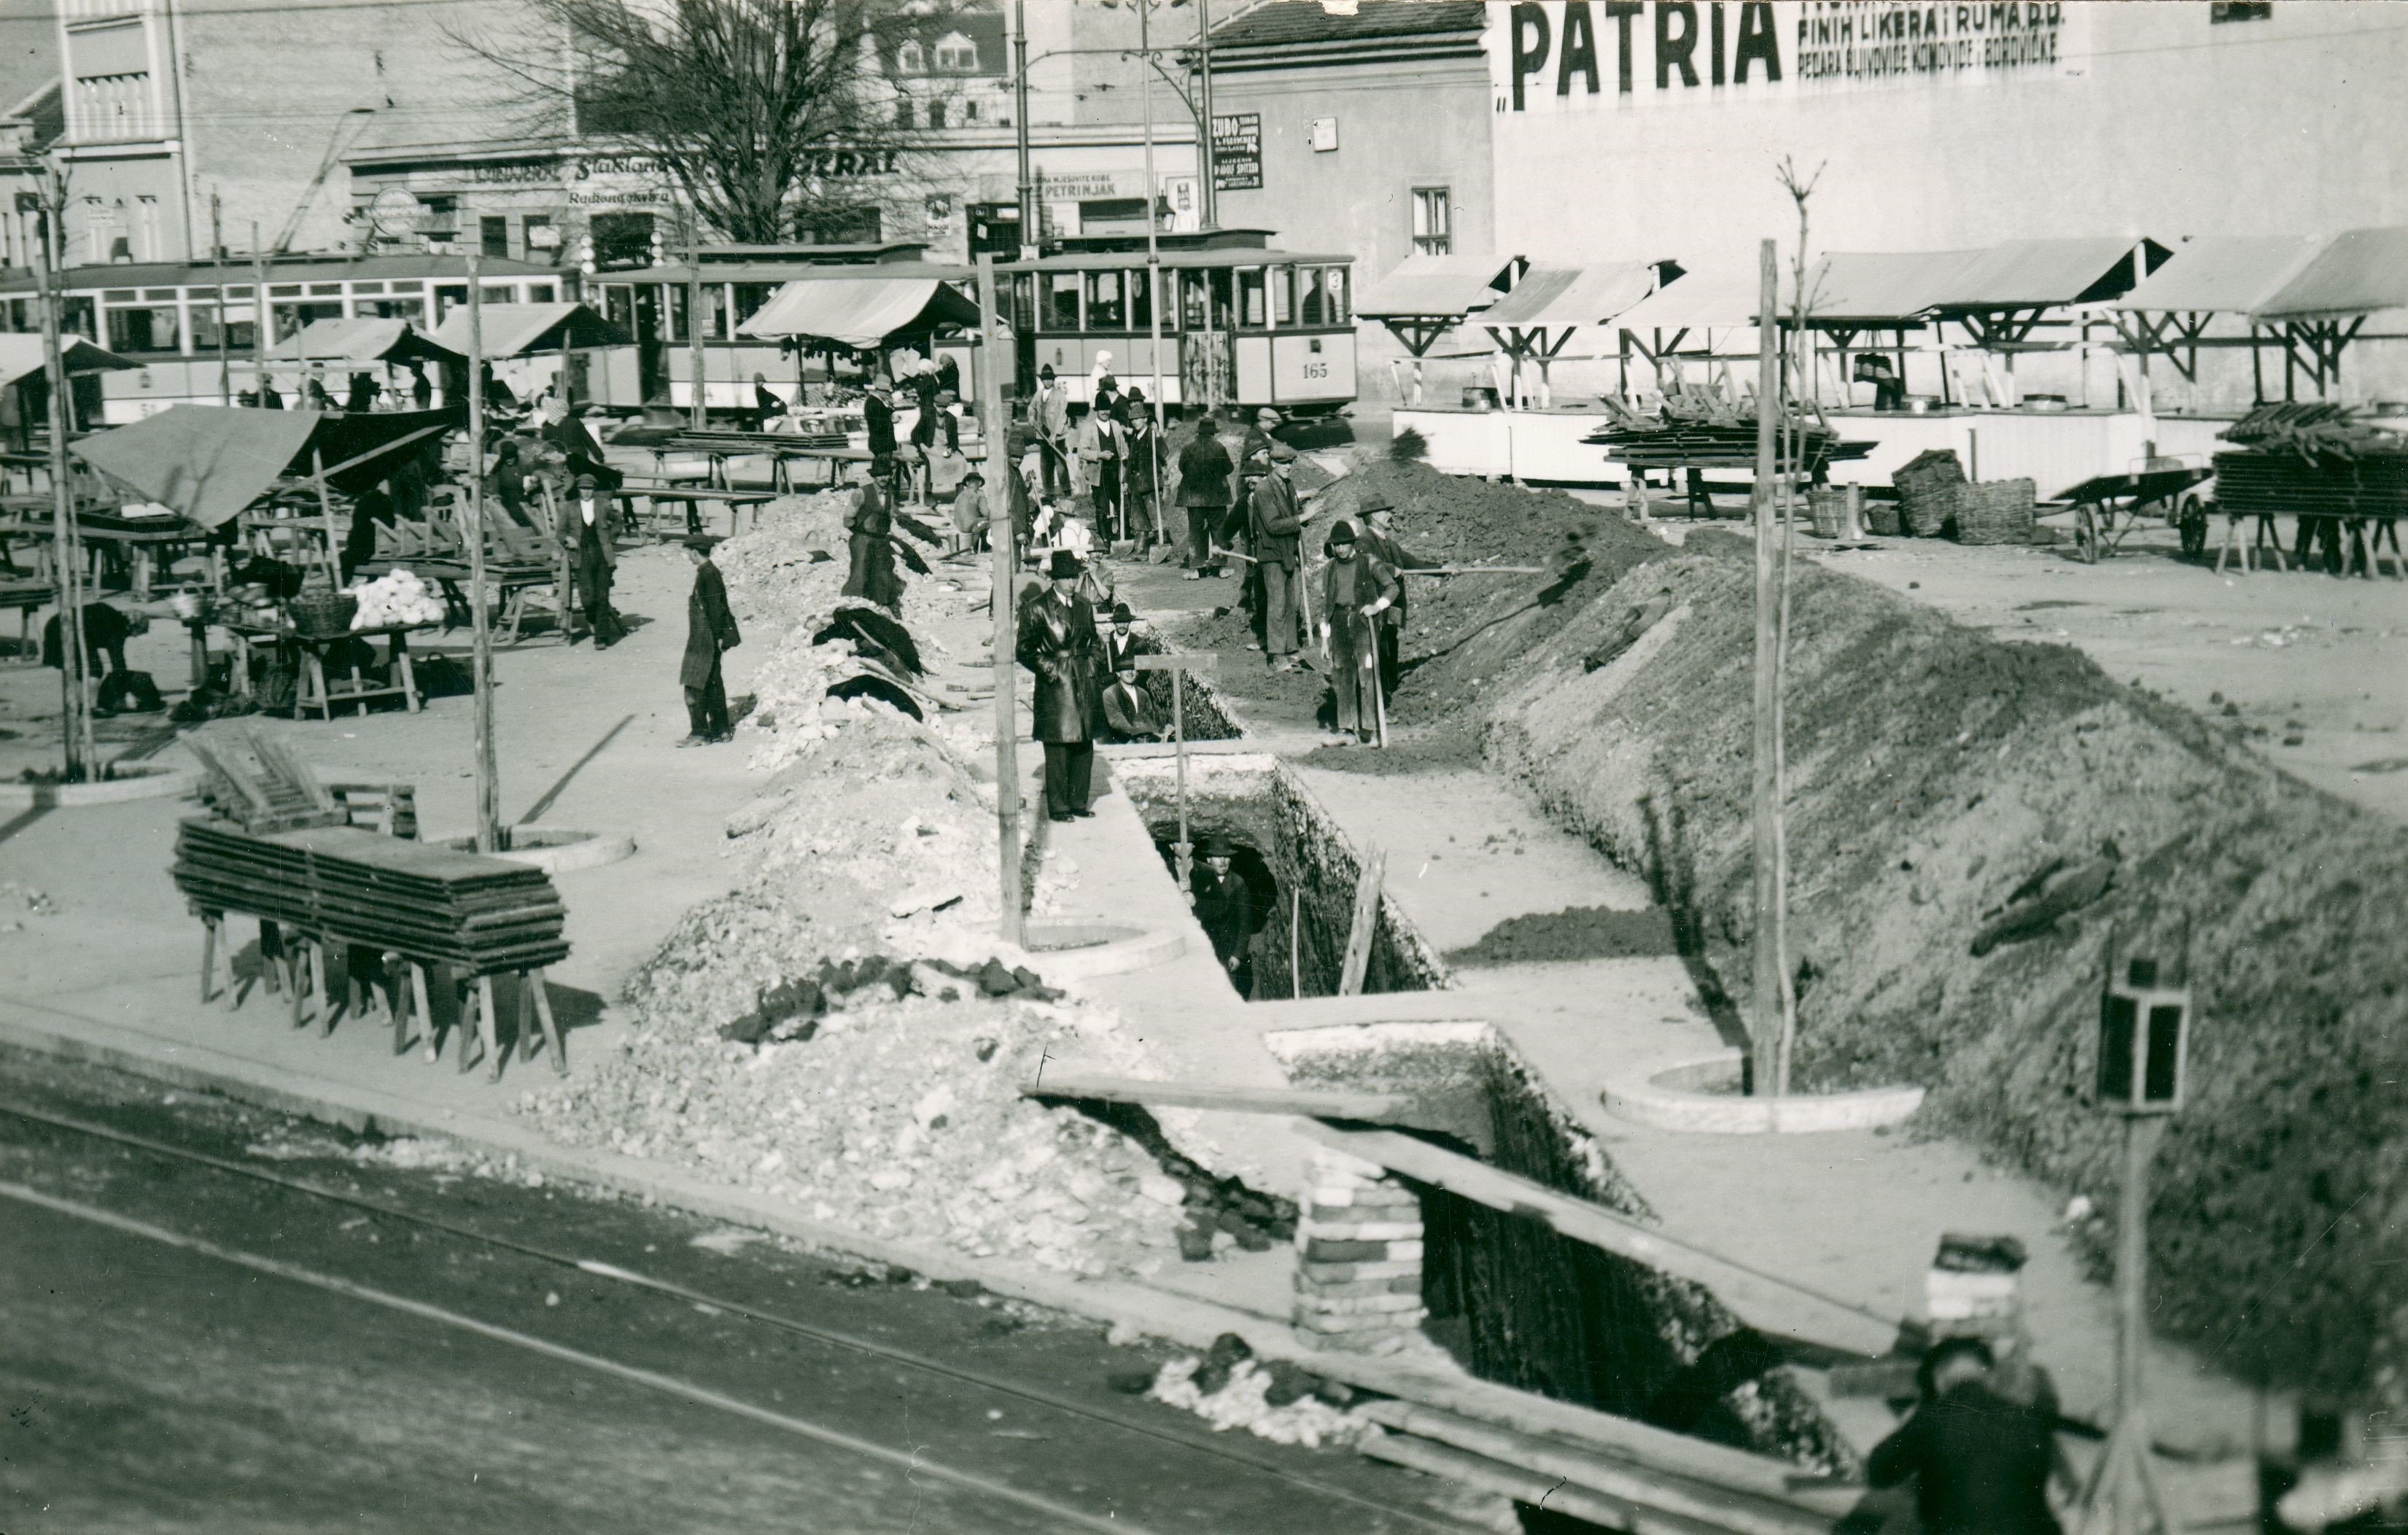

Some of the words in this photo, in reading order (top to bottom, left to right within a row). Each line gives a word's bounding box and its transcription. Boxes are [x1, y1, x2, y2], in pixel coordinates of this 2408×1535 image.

[1798, 15, 1852, 45] FINIH
[1861, 8, 1937, 40] LIKERA
[1237, 162, 1259, 174] SPITZER
[1045, 183, 1115, 197] PETRINJAK
[1331, 273, 1340, 288] 3
[1303, 363, 1328, 379] 165
